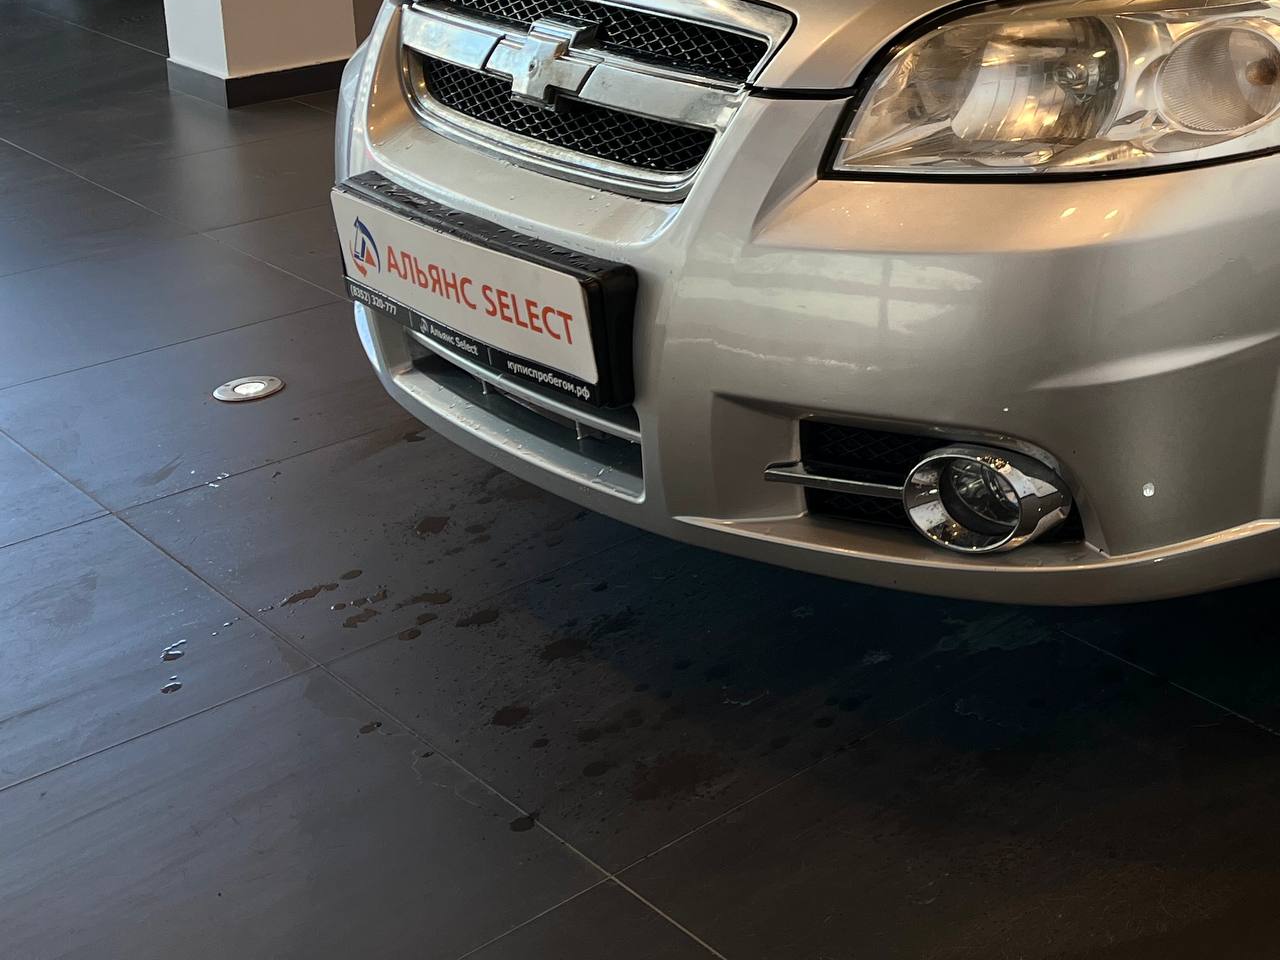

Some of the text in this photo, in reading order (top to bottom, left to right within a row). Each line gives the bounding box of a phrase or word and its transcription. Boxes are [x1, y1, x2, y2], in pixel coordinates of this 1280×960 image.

[386, 245, 573, 345] АЛЬЯНС SELECT
[430, 324, 479, 356] Альянс Select
[507, 360, 590, 400] куписпробегом.рф
